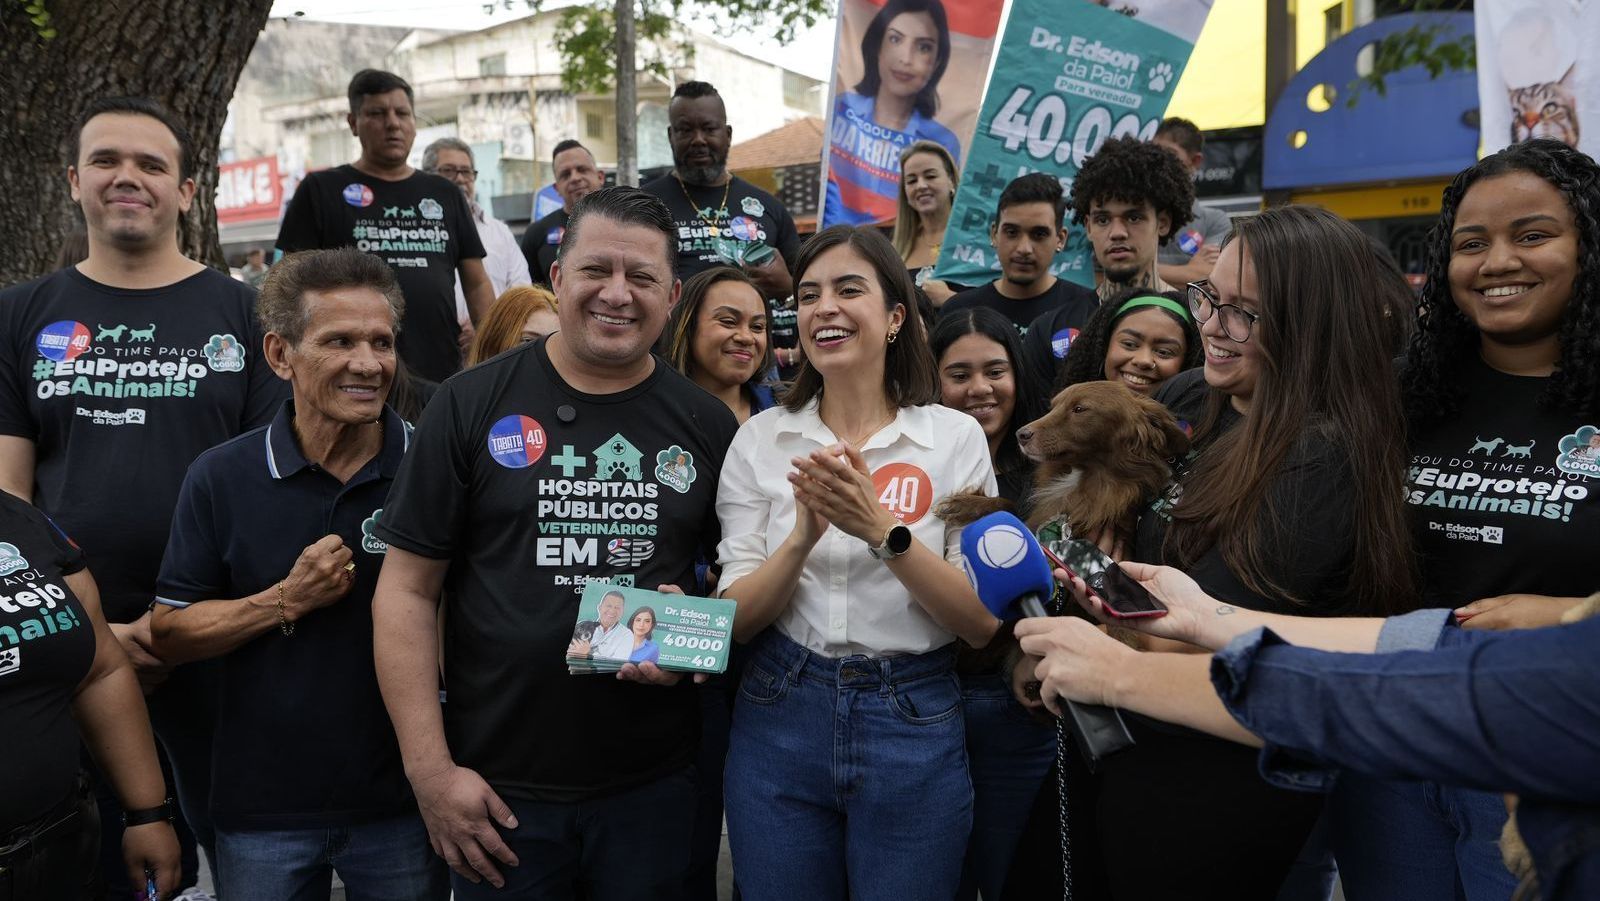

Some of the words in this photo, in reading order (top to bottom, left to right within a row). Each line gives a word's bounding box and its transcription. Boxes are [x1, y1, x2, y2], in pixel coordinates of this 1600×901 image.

[1029, 26, 1064, 53] Dr.
[1067, 36, 1140, 72] Edson
[1063, 59, 1087, 79] da
[1089, 64, 1136, 90] Paiol
[1059, 79, 1085, 94] Para
[1088, 89, 1137, 106] vereador
[352, 225, 450, 243] #EuProtejo
[357, 239, 447, 253] OsAnimais!
[952, 243, 985, 267] NA
[114, 346, 152, 357] TIME
[159, 347, 206, 358] PAIOL
[32, 356, 208, 381] #EuProtejo
[37, 375, 197, 400] OsAnimais!
[75, 406, 93, 417] Dr.
[93, 409, 126, 420] Edson
[491, 434, 524, 452] TABATA
[526, 428, 543, 446] 40
[1412, 455, 1442, 465] SOU
[1449, 458, 1474, 469] DO
[1483, 462, 1525, 474] TIME
[538, 479, 659, 499] HOSPITAIS
[658, 470, 687, 490] 40000
[878, 476, 919, 514] 40
[538, 497, 659, 520] PÚBLICOS
[538, 521, 658, 536] VETERINÁRIOS
[1429, 521, 1445, 531] Dr.
[1446, 523, 1480, 534] Edson
[1446, 532, 1457, 540] da
[1458, 532, 1479, 542] Paiol
[536, 537, 598, 566] EM
[3, 568, 45, 586] AIOL
[554, 575, 572, 586] Dr.
[664, 606, 680, 616] Dr.
[680, 608, 711, 620] Edson
[679, 617, 690, 625] da
[690, 617, 710, 627] Paiol
[662, 633, 724, 652] 40000
[691, 654, 716, 668] 40
